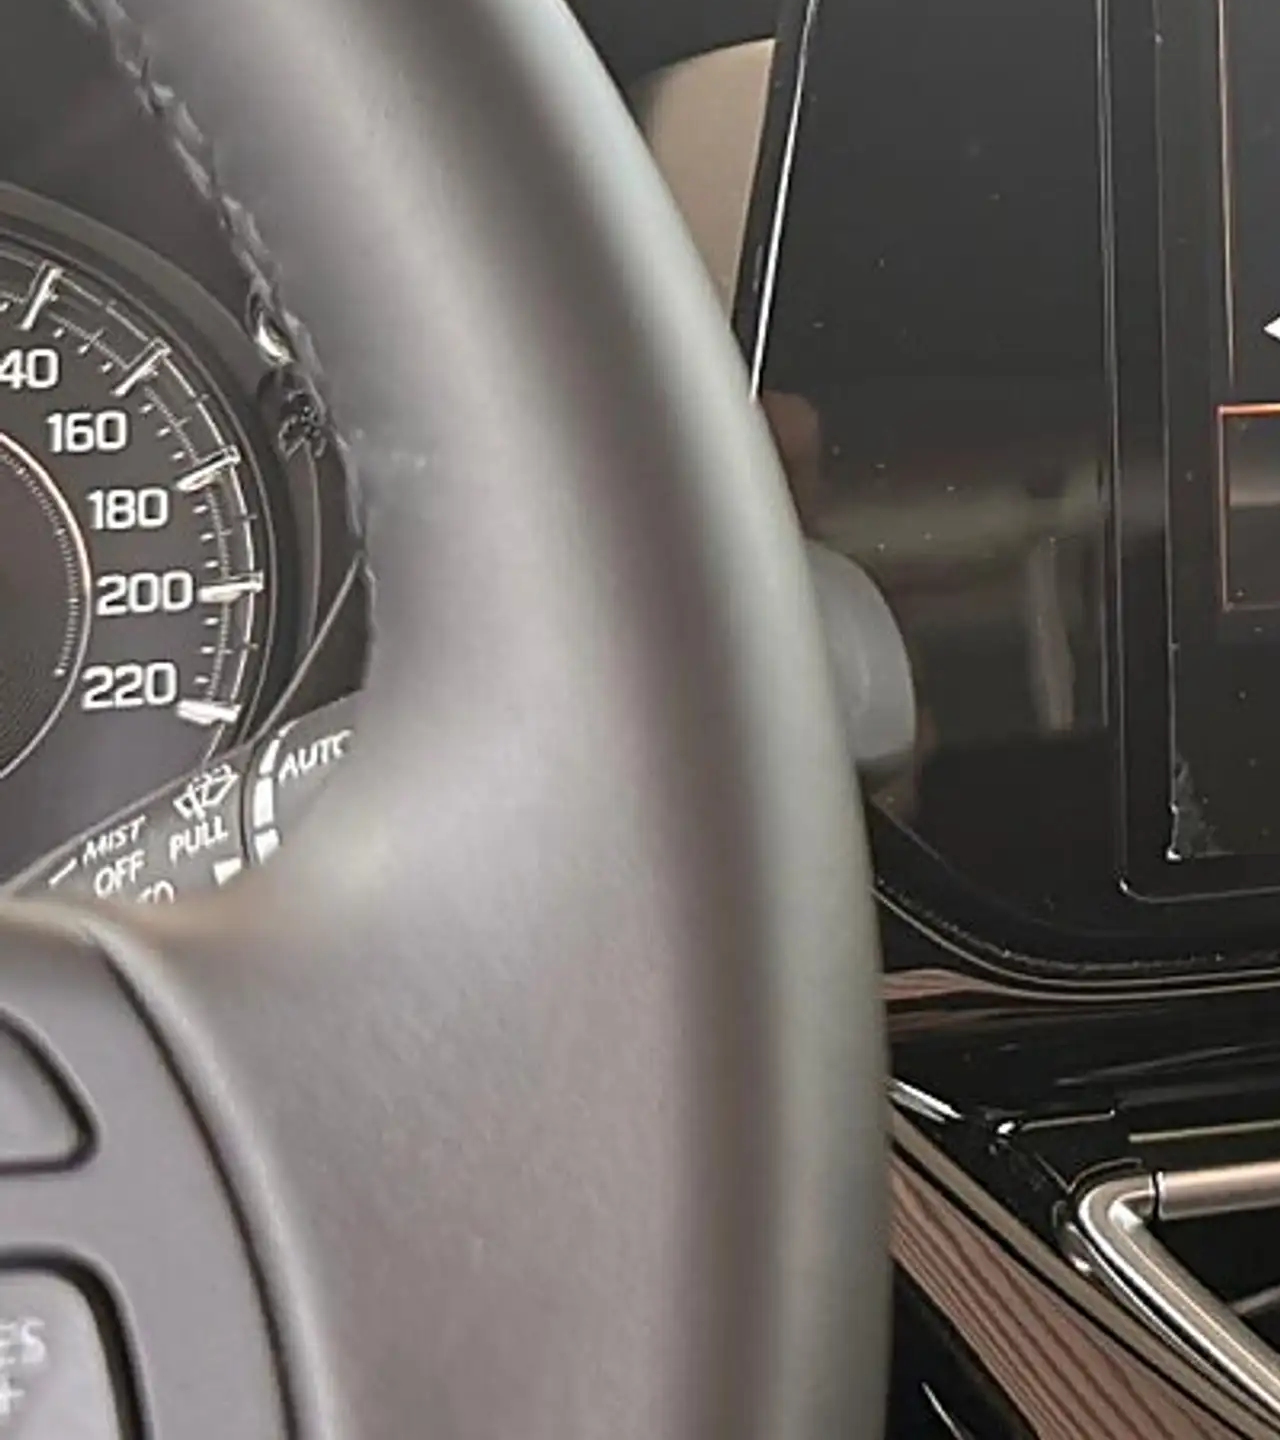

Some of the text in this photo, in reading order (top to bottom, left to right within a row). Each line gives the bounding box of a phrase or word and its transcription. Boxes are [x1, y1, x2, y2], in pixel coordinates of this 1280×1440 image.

[0, 348, 59, 390] 40
[46, 410, 129, 453] 160
[86, 488, 169, 530] 180
[95, 570, 194, 616] 200
[81, 662, 178, 710] 220
[82, 813, 147, 867] MIST
[168, 815, 229, 867] PULL
[93, 849, 146, 900] OFF
